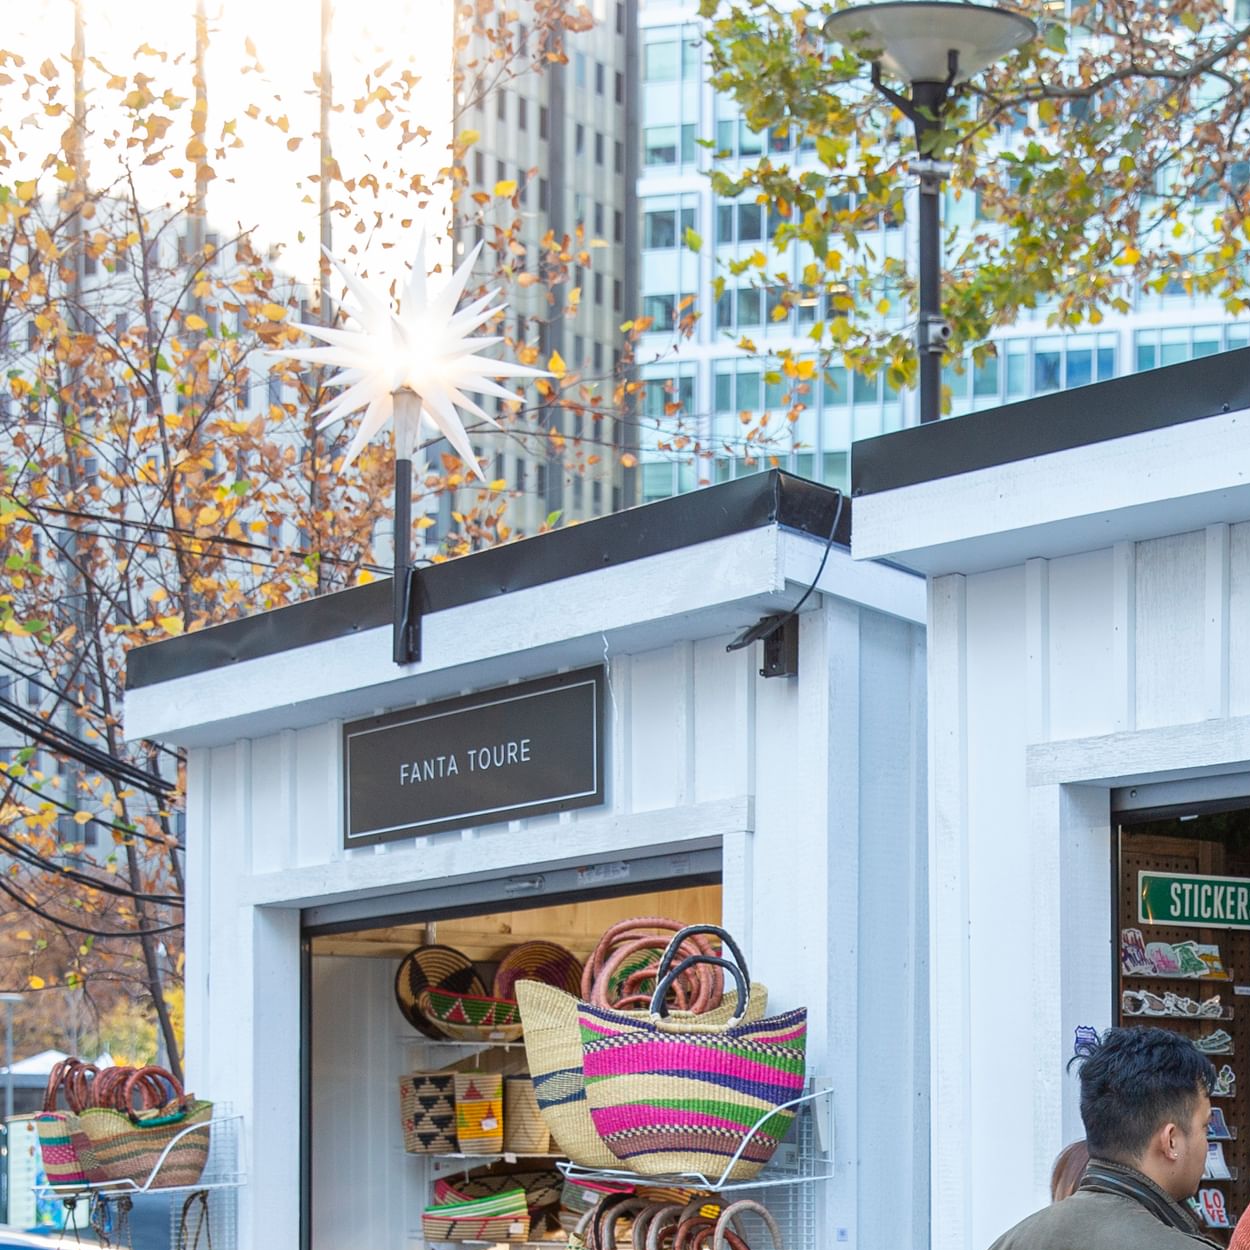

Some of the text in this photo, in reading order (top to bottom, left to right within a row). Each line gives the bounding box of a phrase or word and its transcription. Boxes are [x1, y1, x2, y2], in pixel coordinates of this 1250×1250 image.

[400, 738, 531, 786] FANTA TOURE
[1203, 1191, 1221, 1209] LO
[1207, 1209, 1227, 1224] VE
